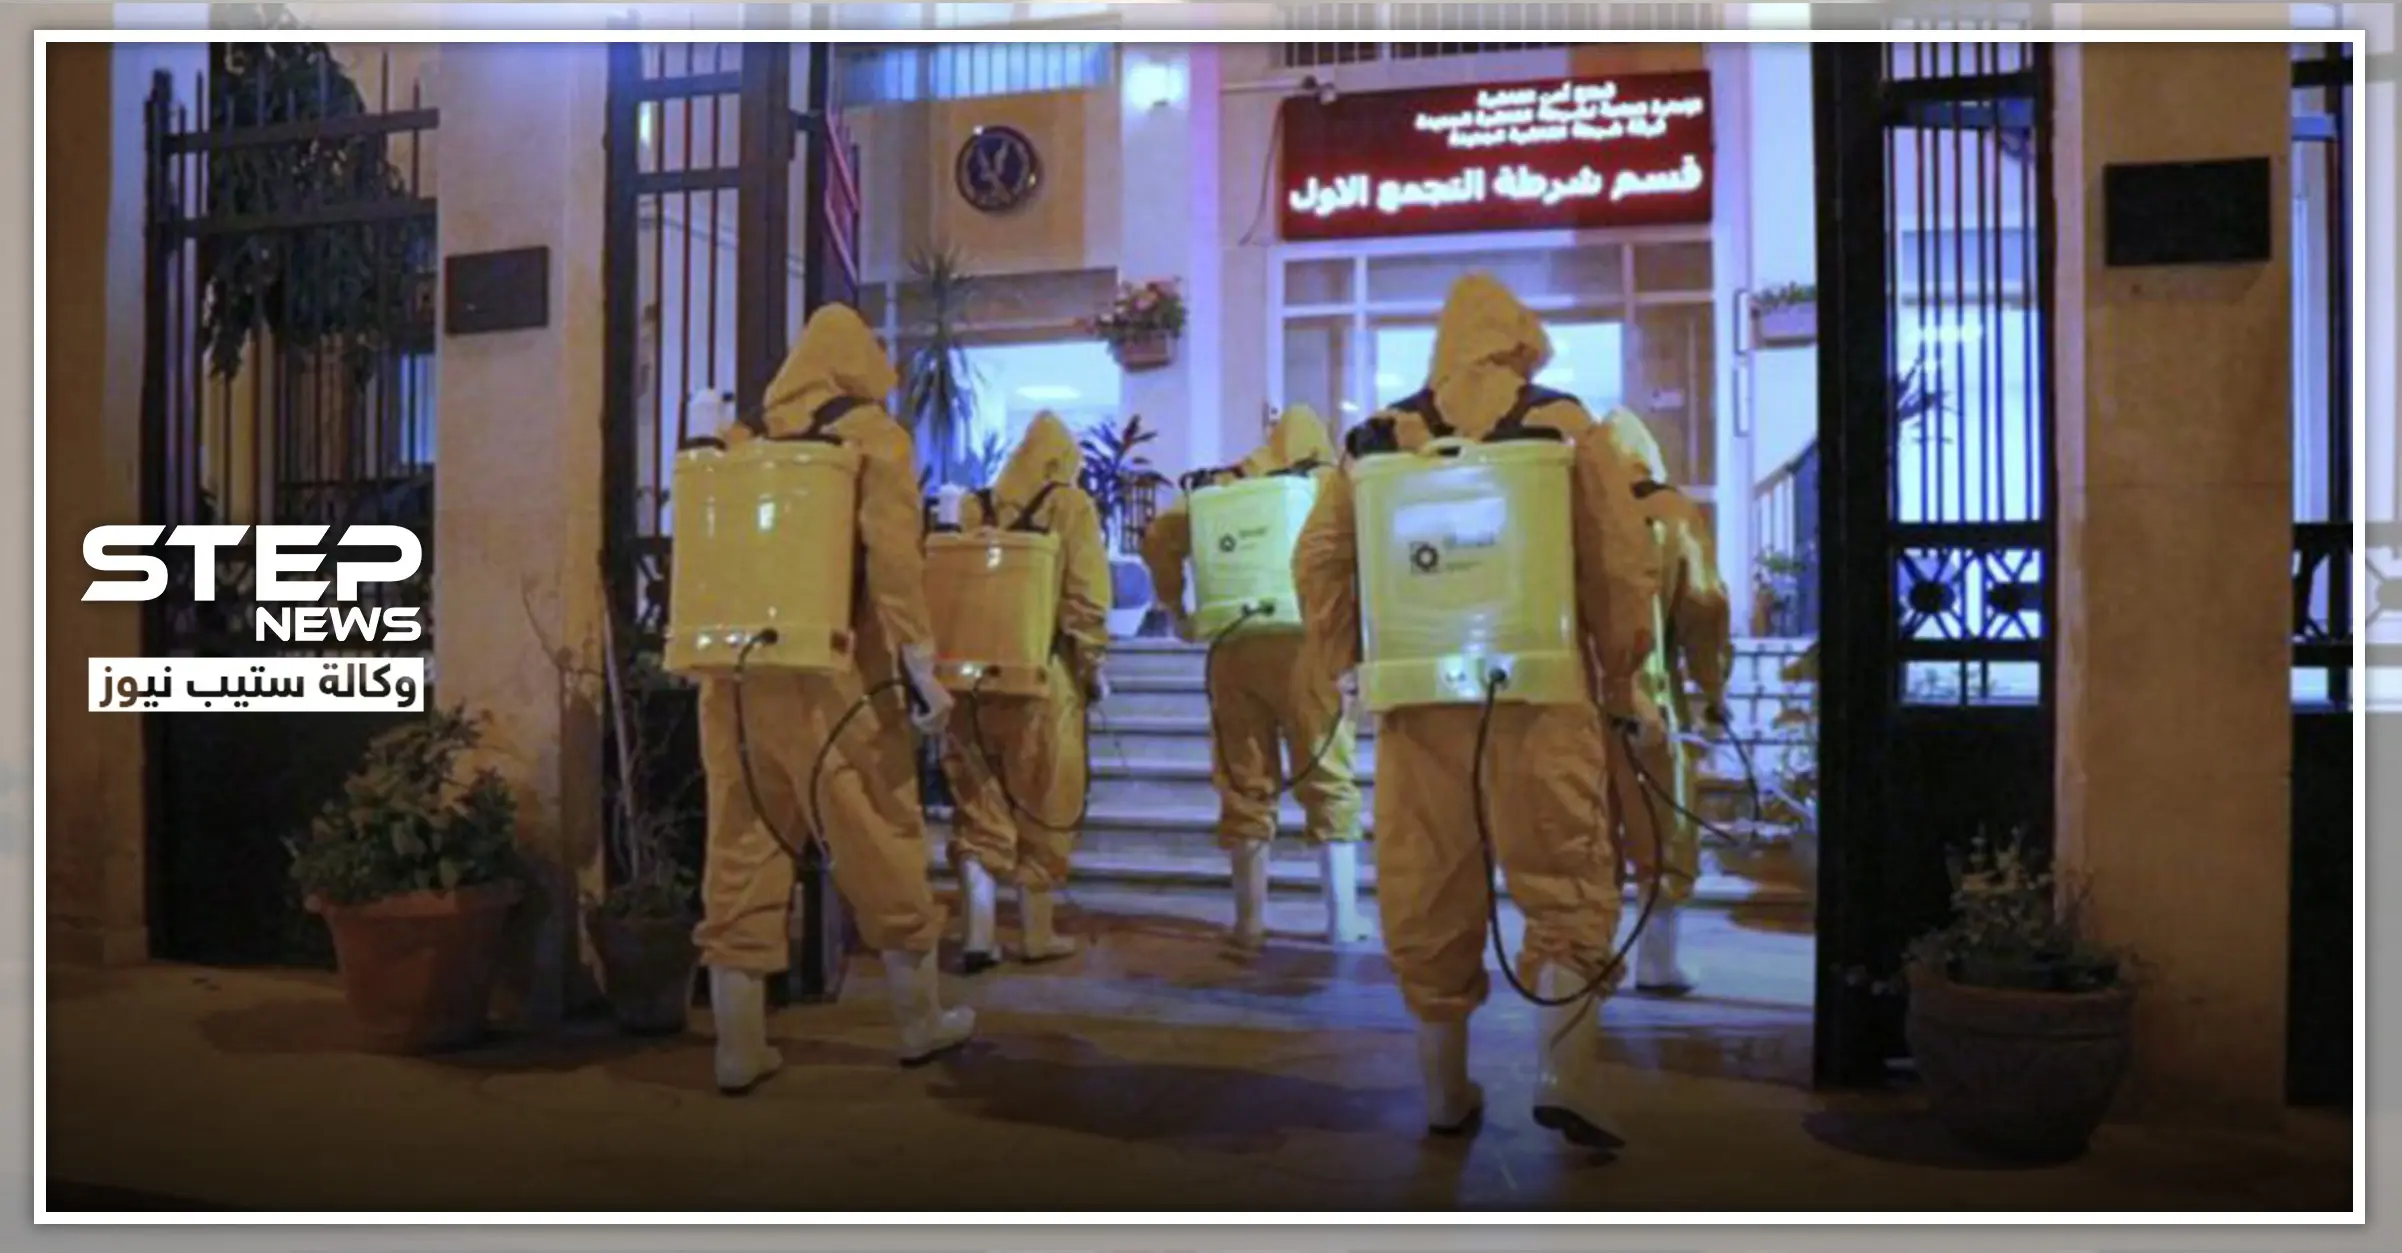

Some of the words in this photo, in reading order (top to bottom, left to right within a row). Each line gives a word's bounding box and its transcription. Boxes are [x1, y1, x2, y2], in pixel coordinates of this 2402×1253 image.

[1376, 167, 1486, 213] التجمع
[1492, 165, 1603, 205] شرطة
[1610, 155, 1703, 200] قسم
